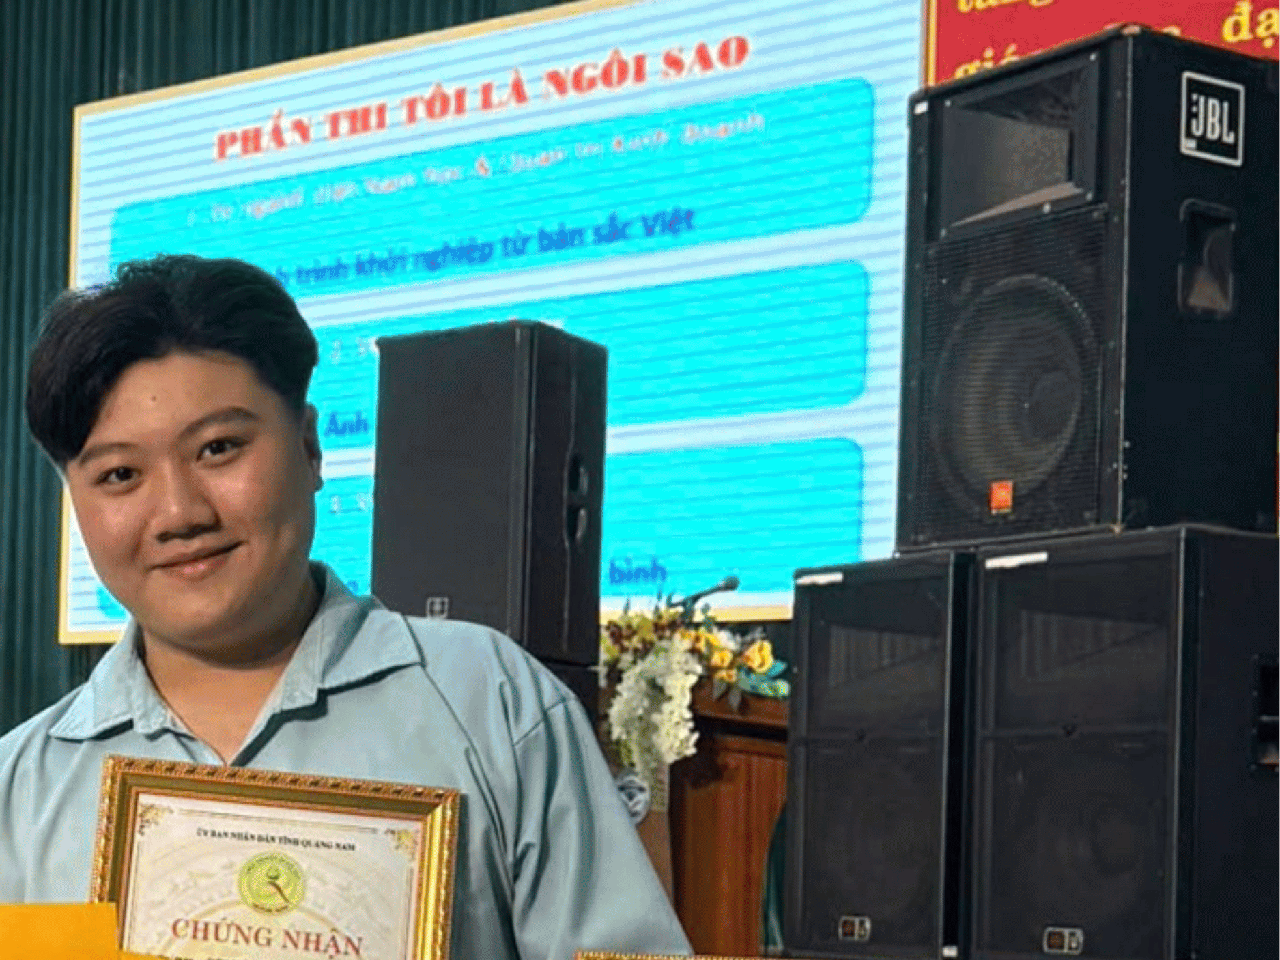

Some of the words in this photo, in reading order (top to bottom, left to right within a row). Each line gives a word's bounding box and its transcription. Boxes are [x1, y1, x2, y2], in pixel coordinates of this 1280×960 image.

[326, 103, 388, 140] THI
[401, 82, 468, 126] TÔI
[479, 67, 529, 111] LÀ
[541, 47, 648, 101] NGÔI
[662, 35, 750, 80] SAO
[1190, 92, 1236, 144] JBL
[640, 206, 696, 241] Việt
[610, 557, 668, 585] bình
[171, 916, 273, 947] CHỨNG
[281, 926, 364, 959] NHẬN
